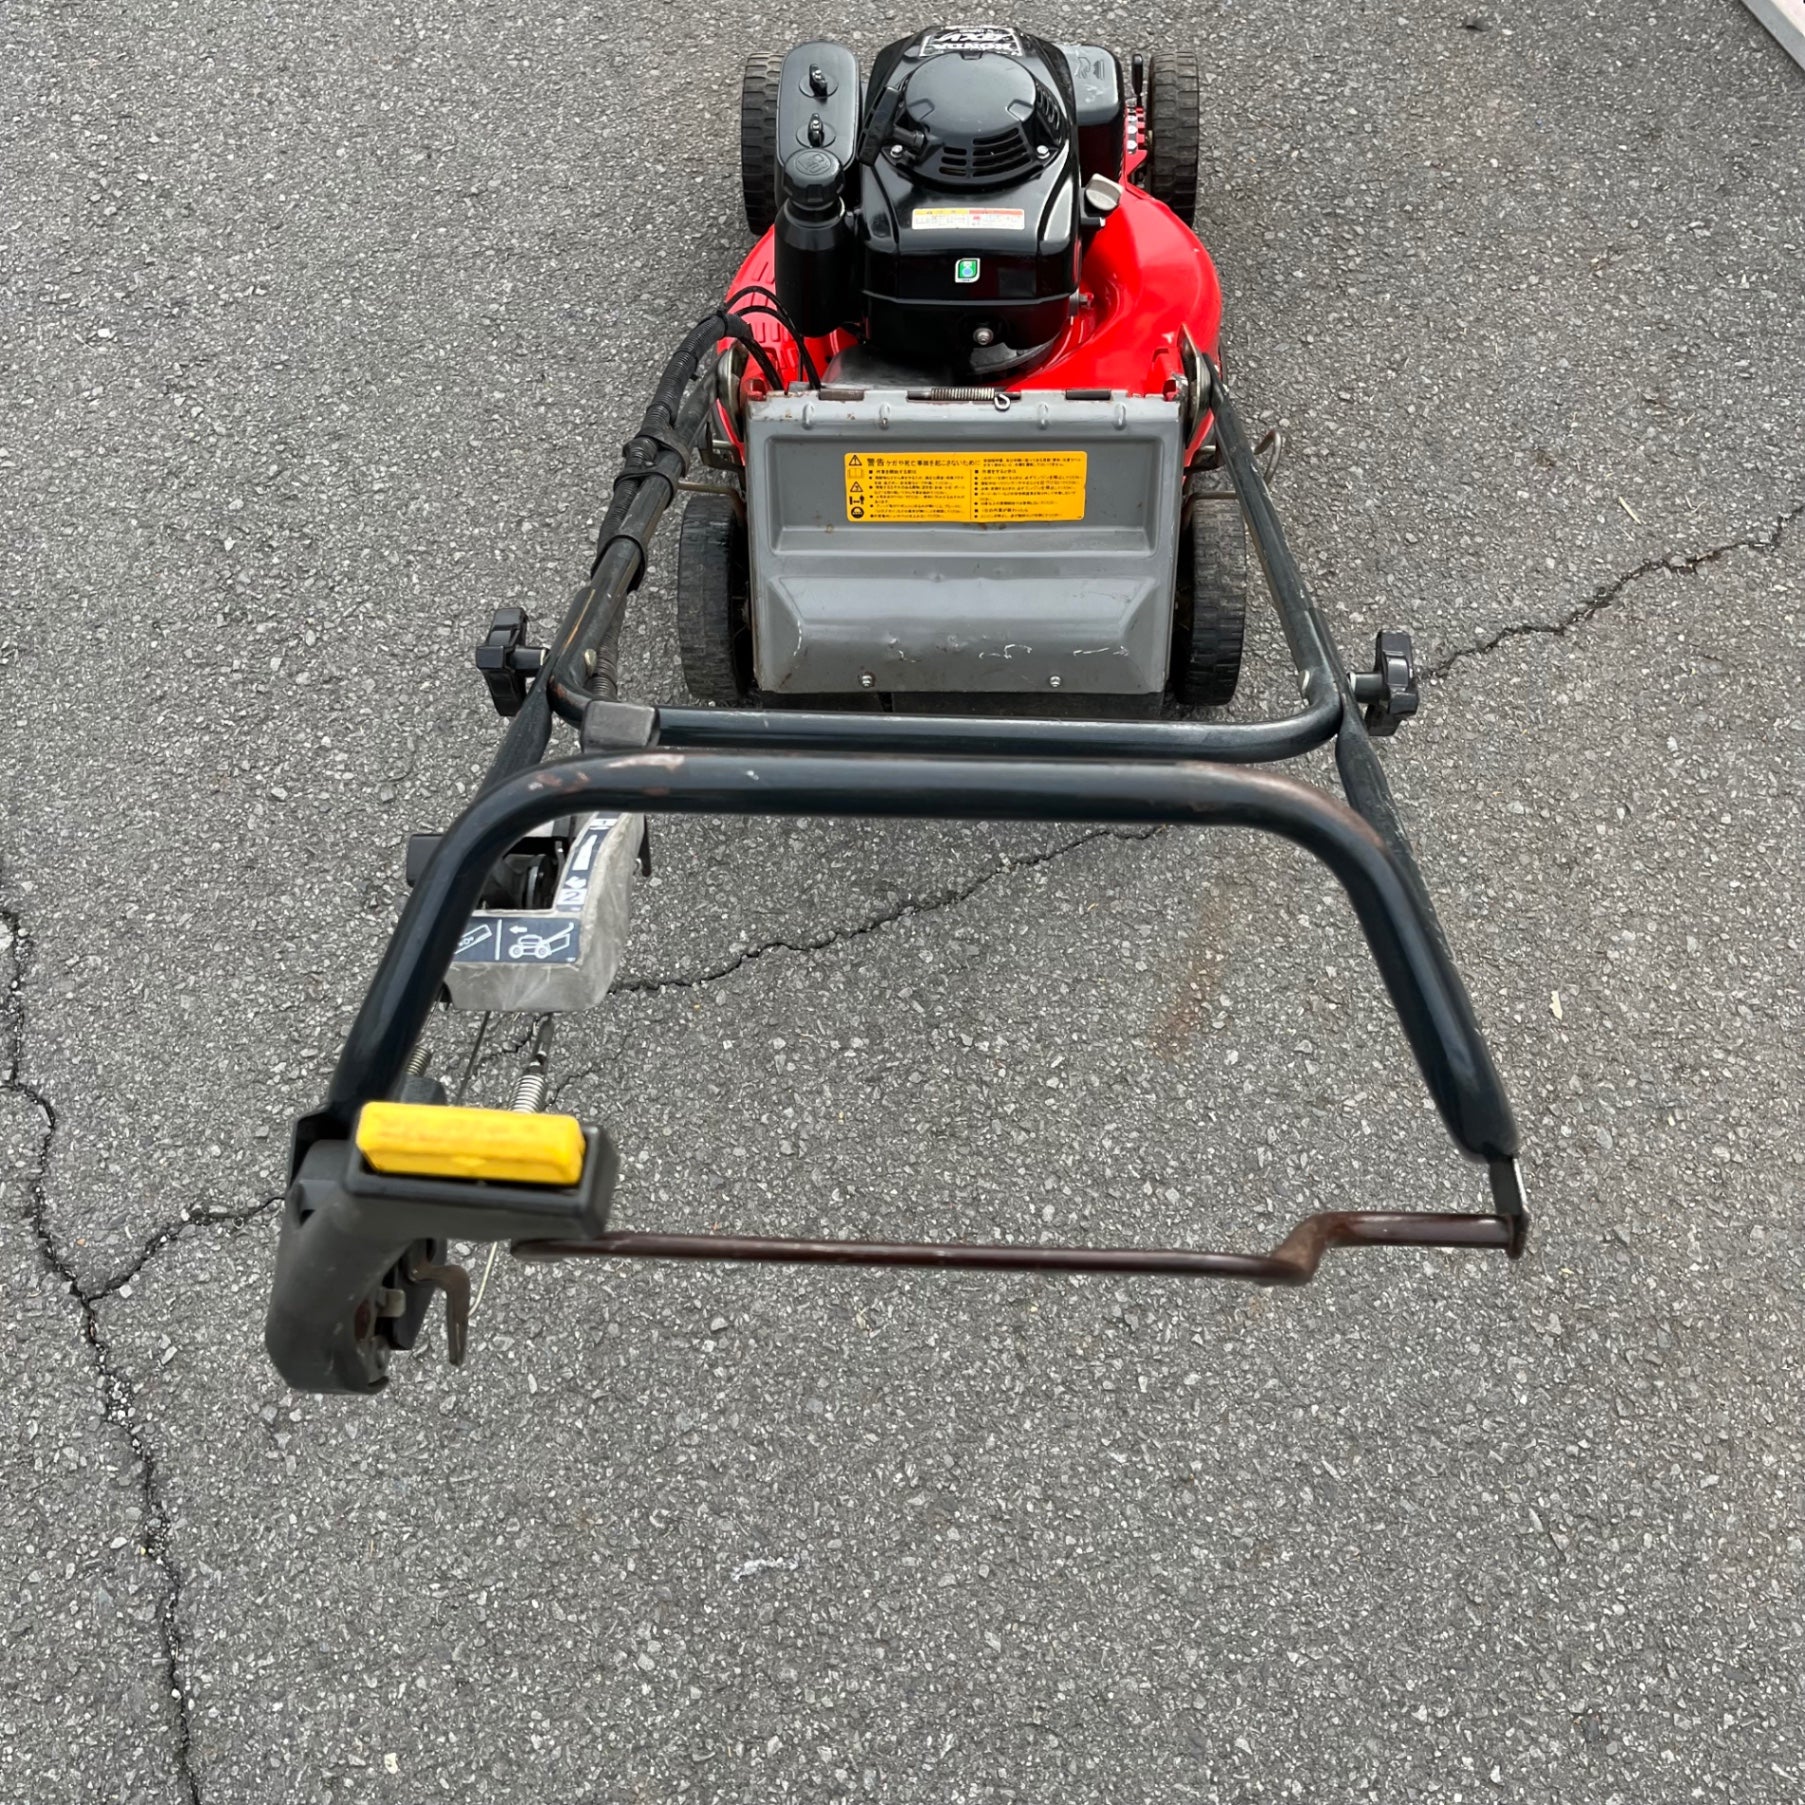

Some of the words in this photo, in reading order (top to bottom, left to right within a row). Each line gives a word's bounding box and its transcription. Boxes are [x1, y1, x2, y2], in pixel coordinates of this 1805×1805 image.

[932, 43, 1012, 51] HONDA
[867, 458, 884, 466] 警告
[563, 890, 580, 902] 2
